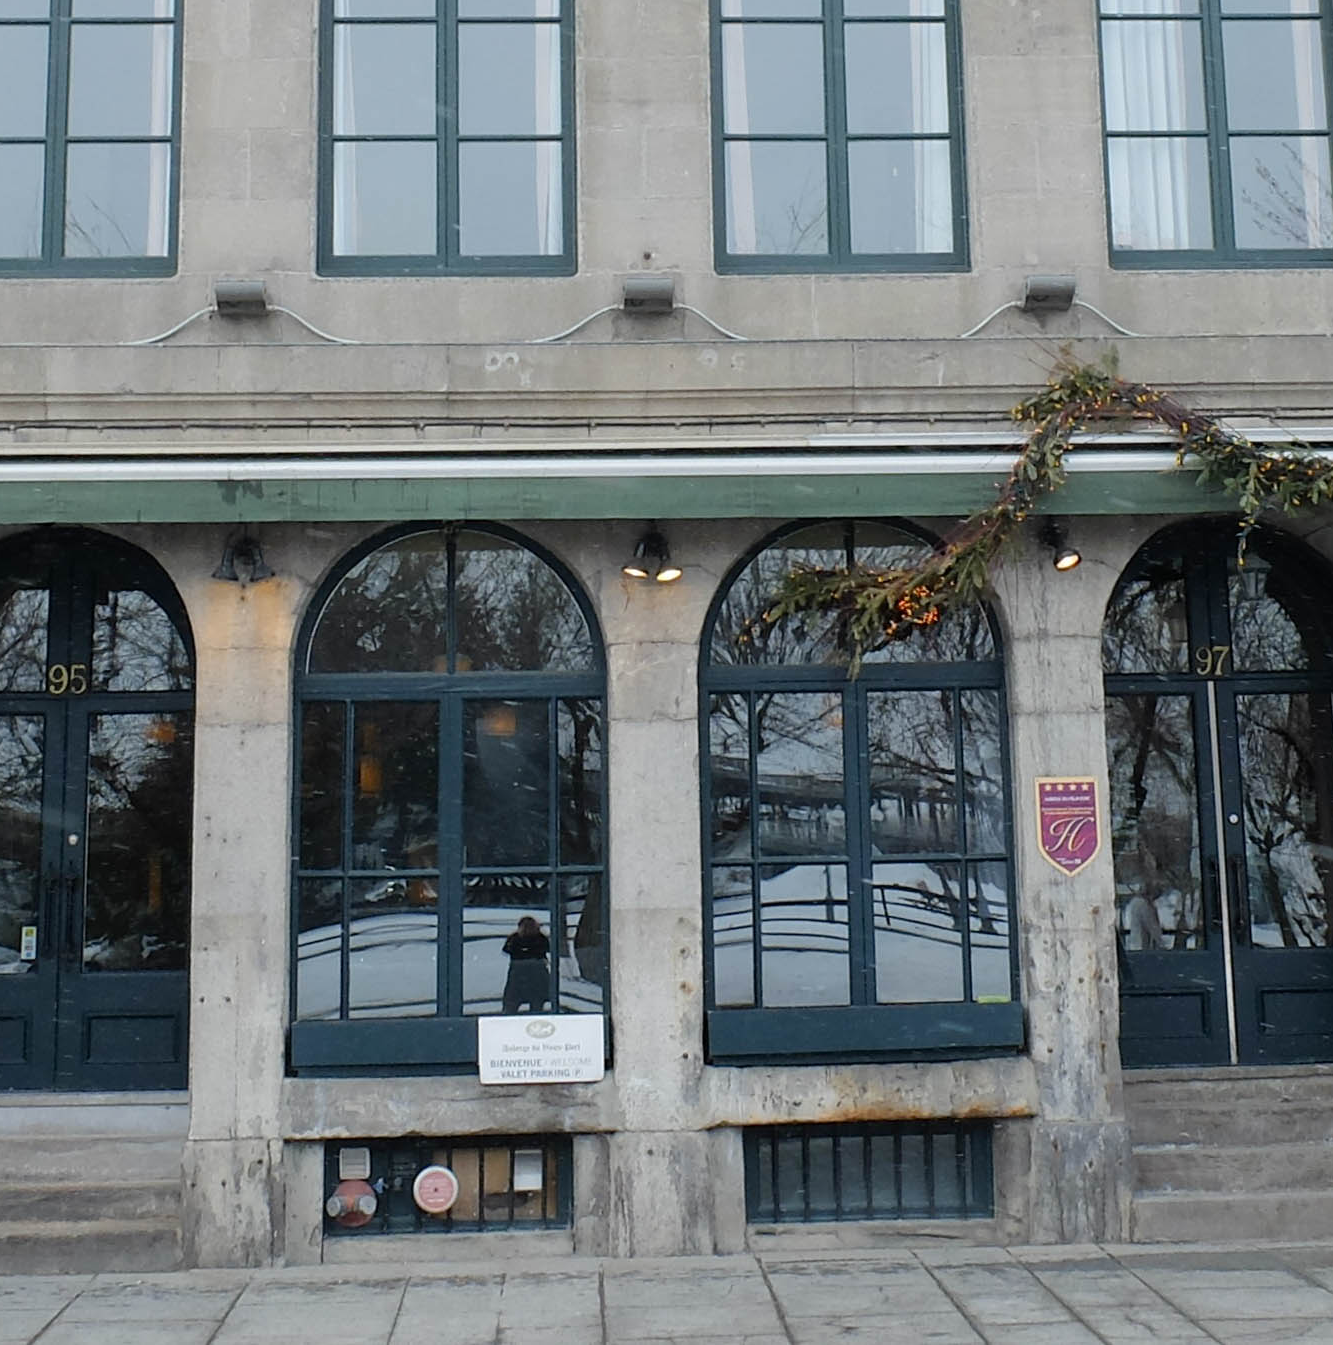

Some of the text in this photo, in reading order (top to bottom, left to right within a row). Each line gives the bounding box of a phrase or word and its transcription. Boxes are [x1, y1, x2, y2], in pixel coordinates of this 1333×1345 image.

[1195, 645, 1230, 676] 97
[48, 664, 87, 694] 95
[490, 1058, 543, 1069] BIENVENUE
[500, 1069, 528, 1079] VALET
[530, 1068, 571, 1078] PARKING
